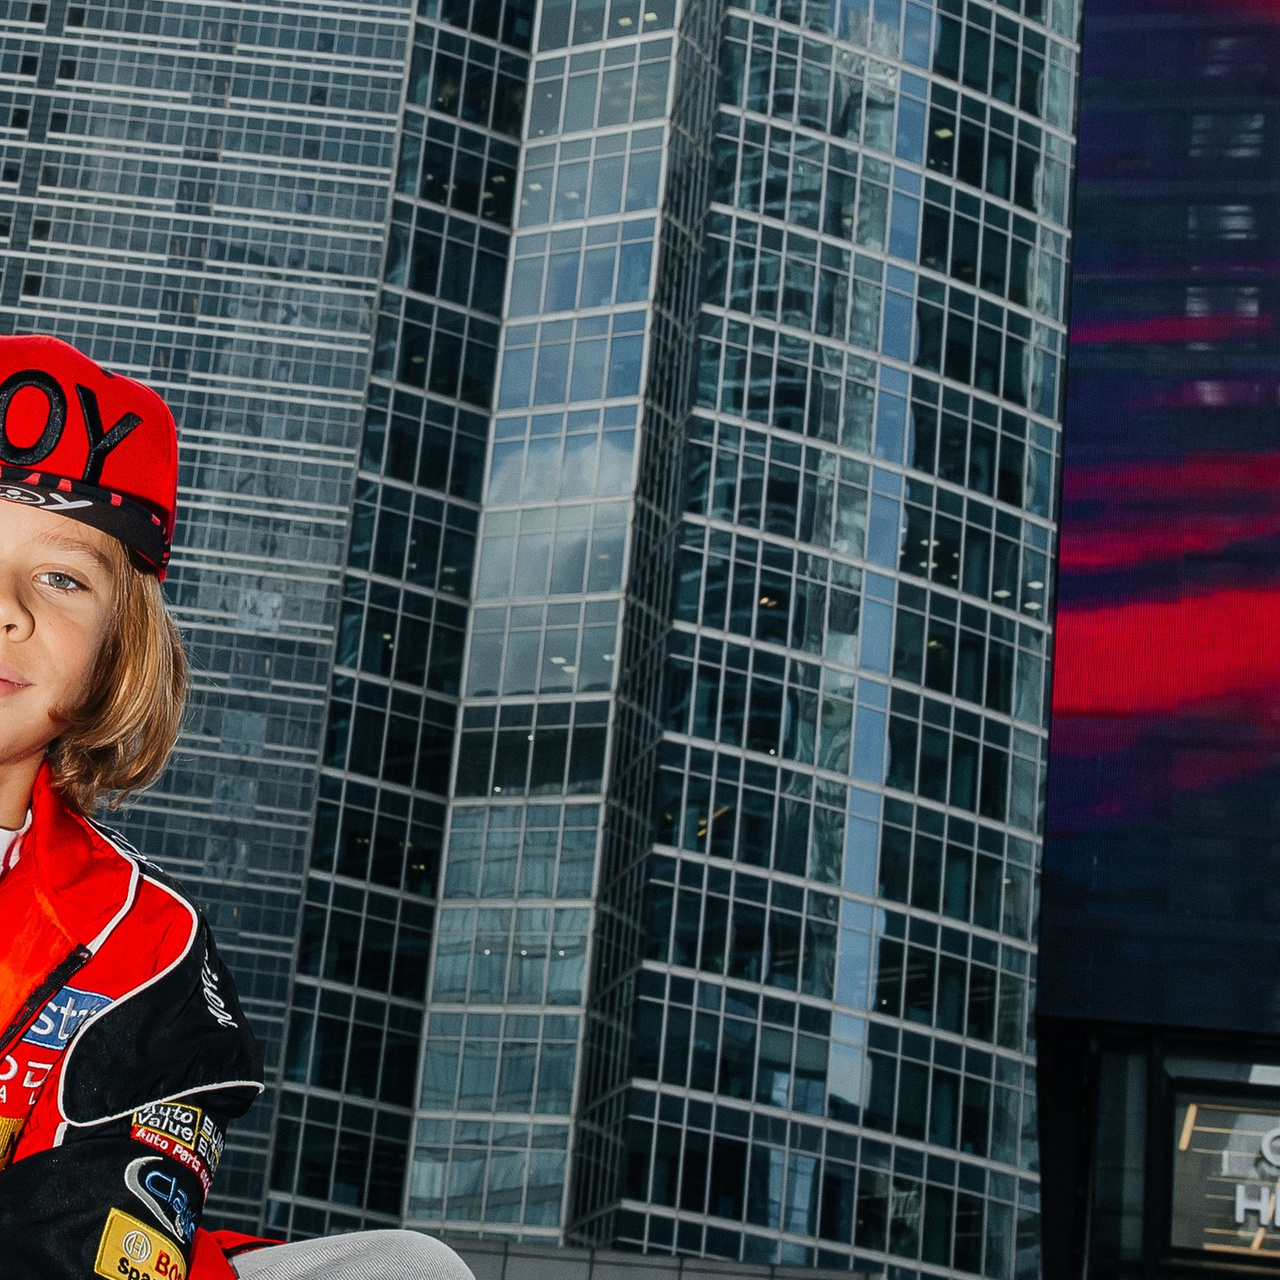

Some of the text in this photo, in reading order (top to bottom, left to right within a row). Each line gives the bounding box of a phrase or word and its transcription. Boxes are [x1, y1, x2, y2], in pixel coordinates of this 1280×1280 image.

[138, 1112, 193, 1141] Value
[143, 1105, 193, 1124] Auto
[136, 1128, 169, 1150] Auto
[172, 1145, 200, 1172] Parts
